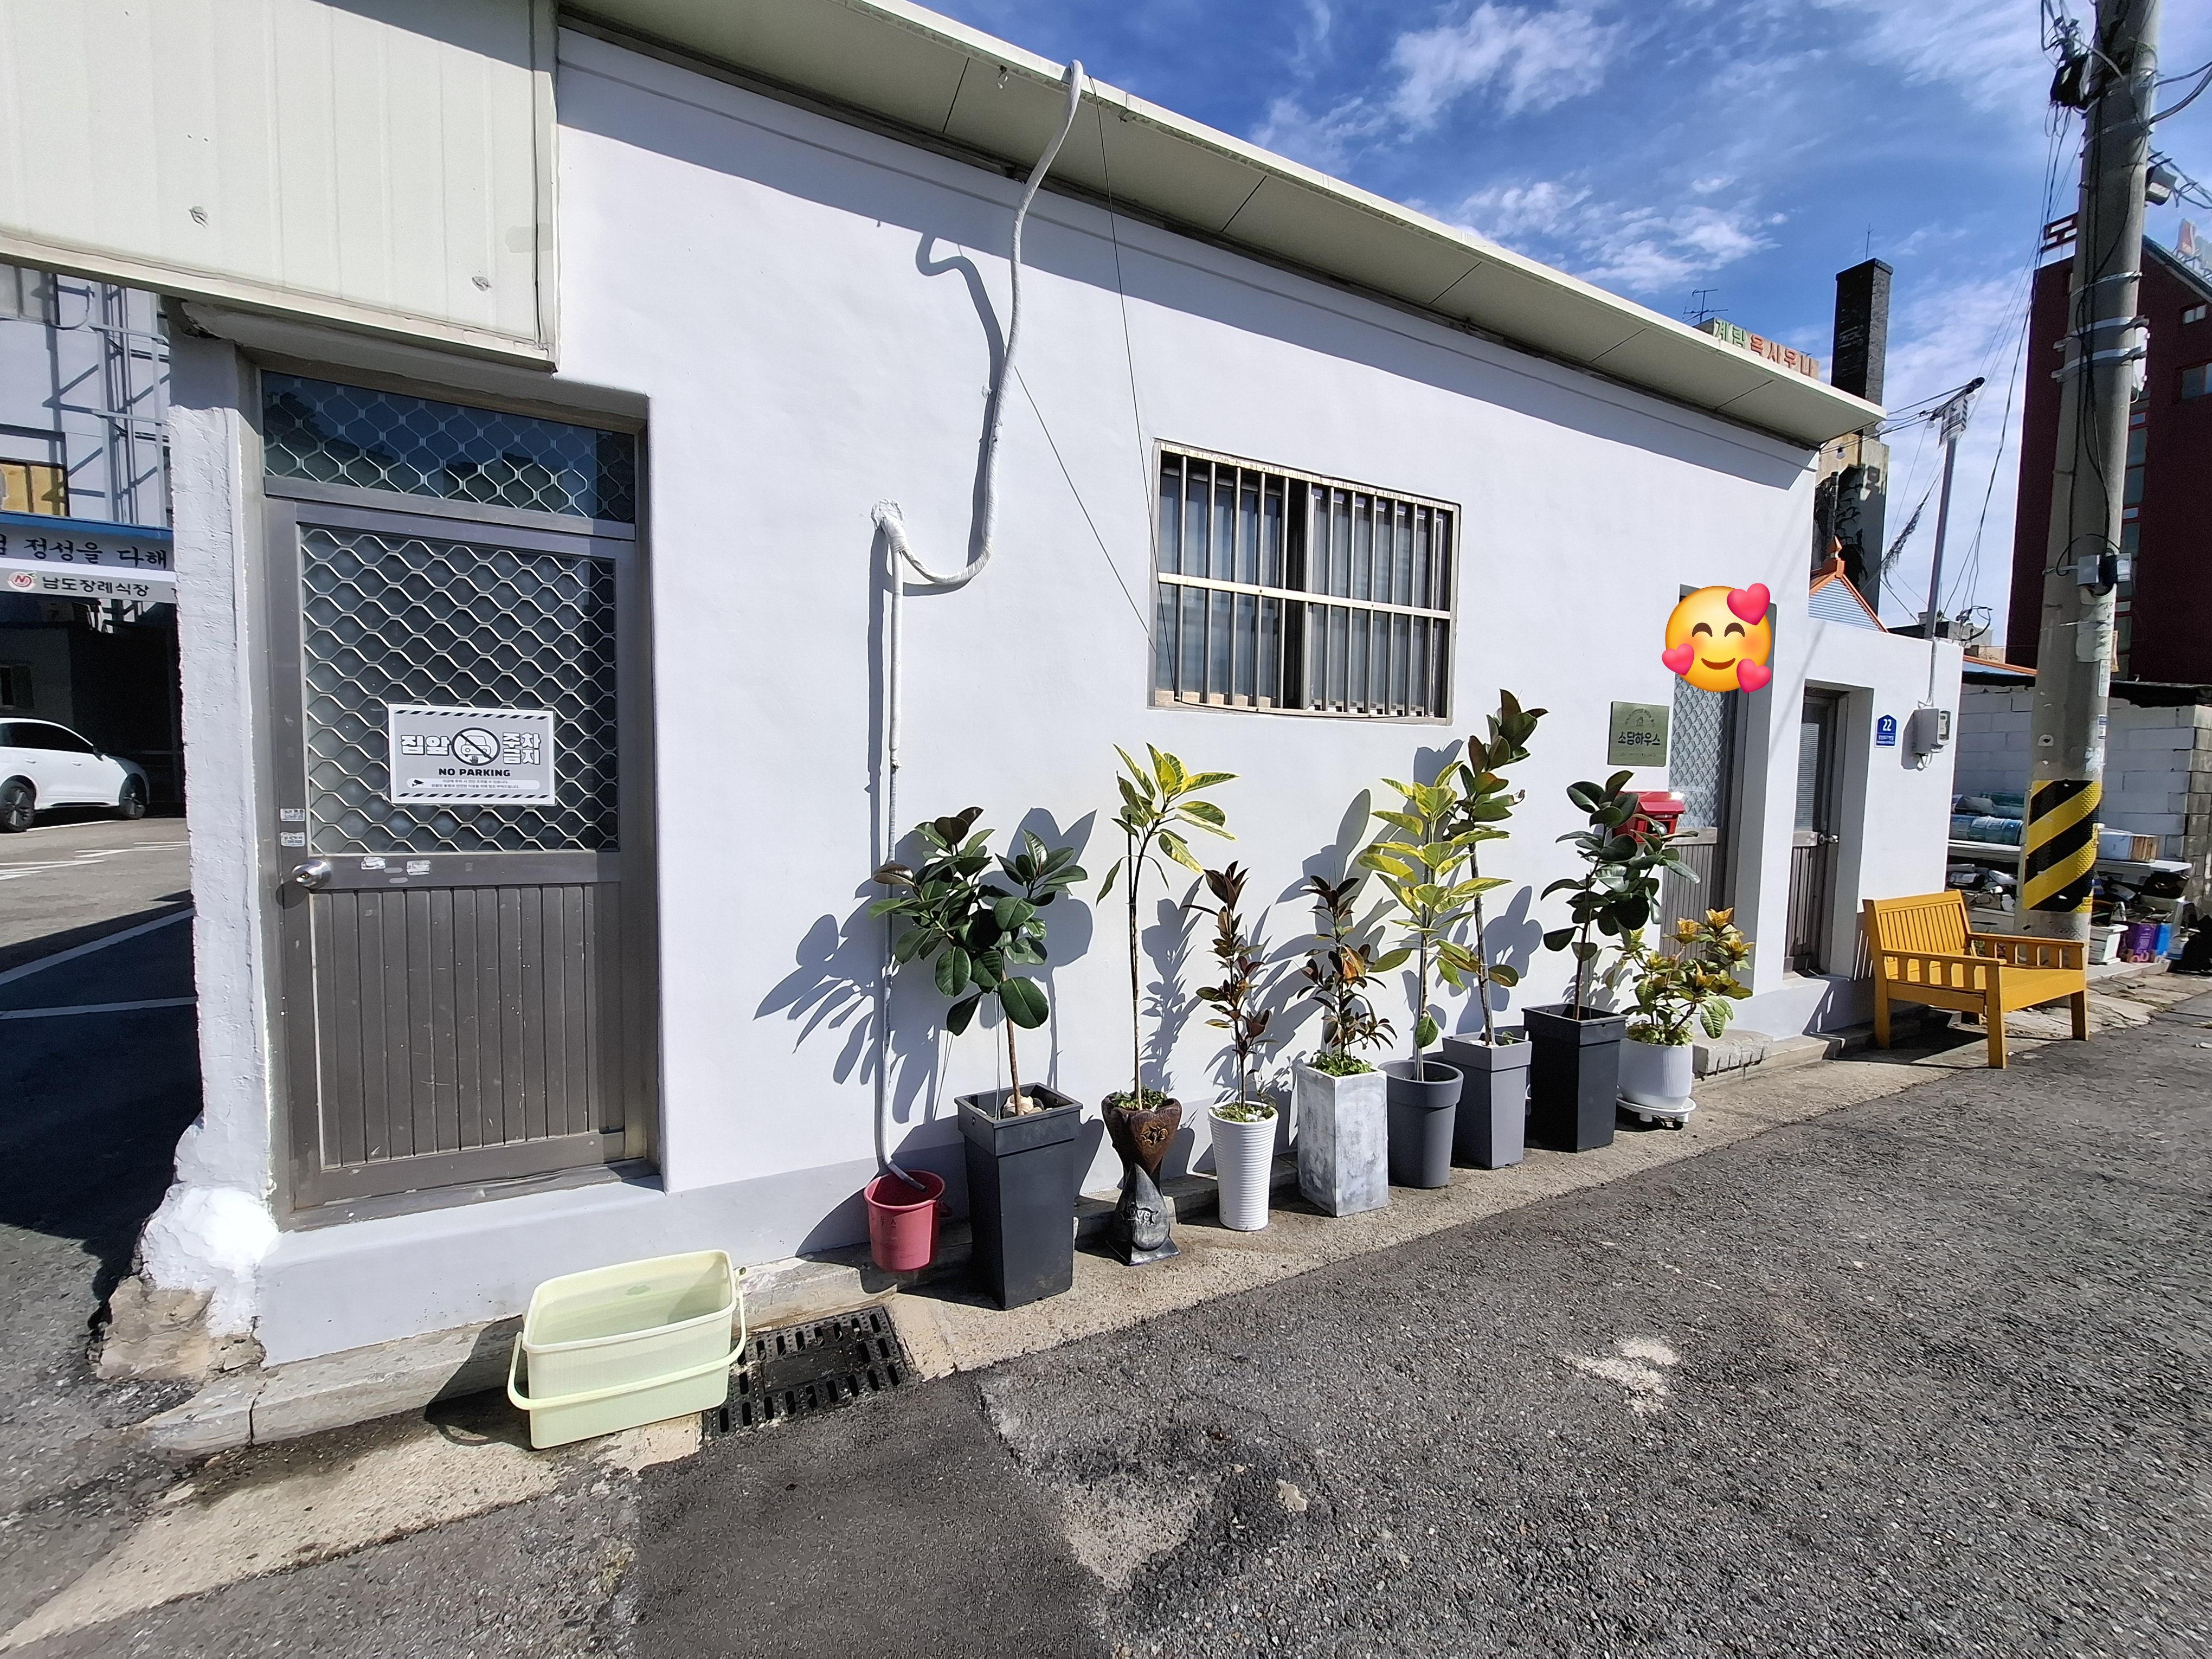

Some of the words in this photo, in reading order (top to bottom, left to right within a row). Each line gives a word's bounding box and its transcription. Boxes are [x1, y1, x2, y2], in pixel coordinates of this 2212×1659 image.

[24, 537, 103, 564] 정성을
[117, 546, 168, 569] 다해
[42, 576, 150, 597] 남도장례식장
[1882, 718, 1892, 731] 22
[502, 732, 542, 749] 주차
[1618, 731, 1661, 746] 소담하우스
[503, 748, 541, 765] 금지
[439, 768, 455, 776] NO
[459, 768, 511, 777] PARKING
